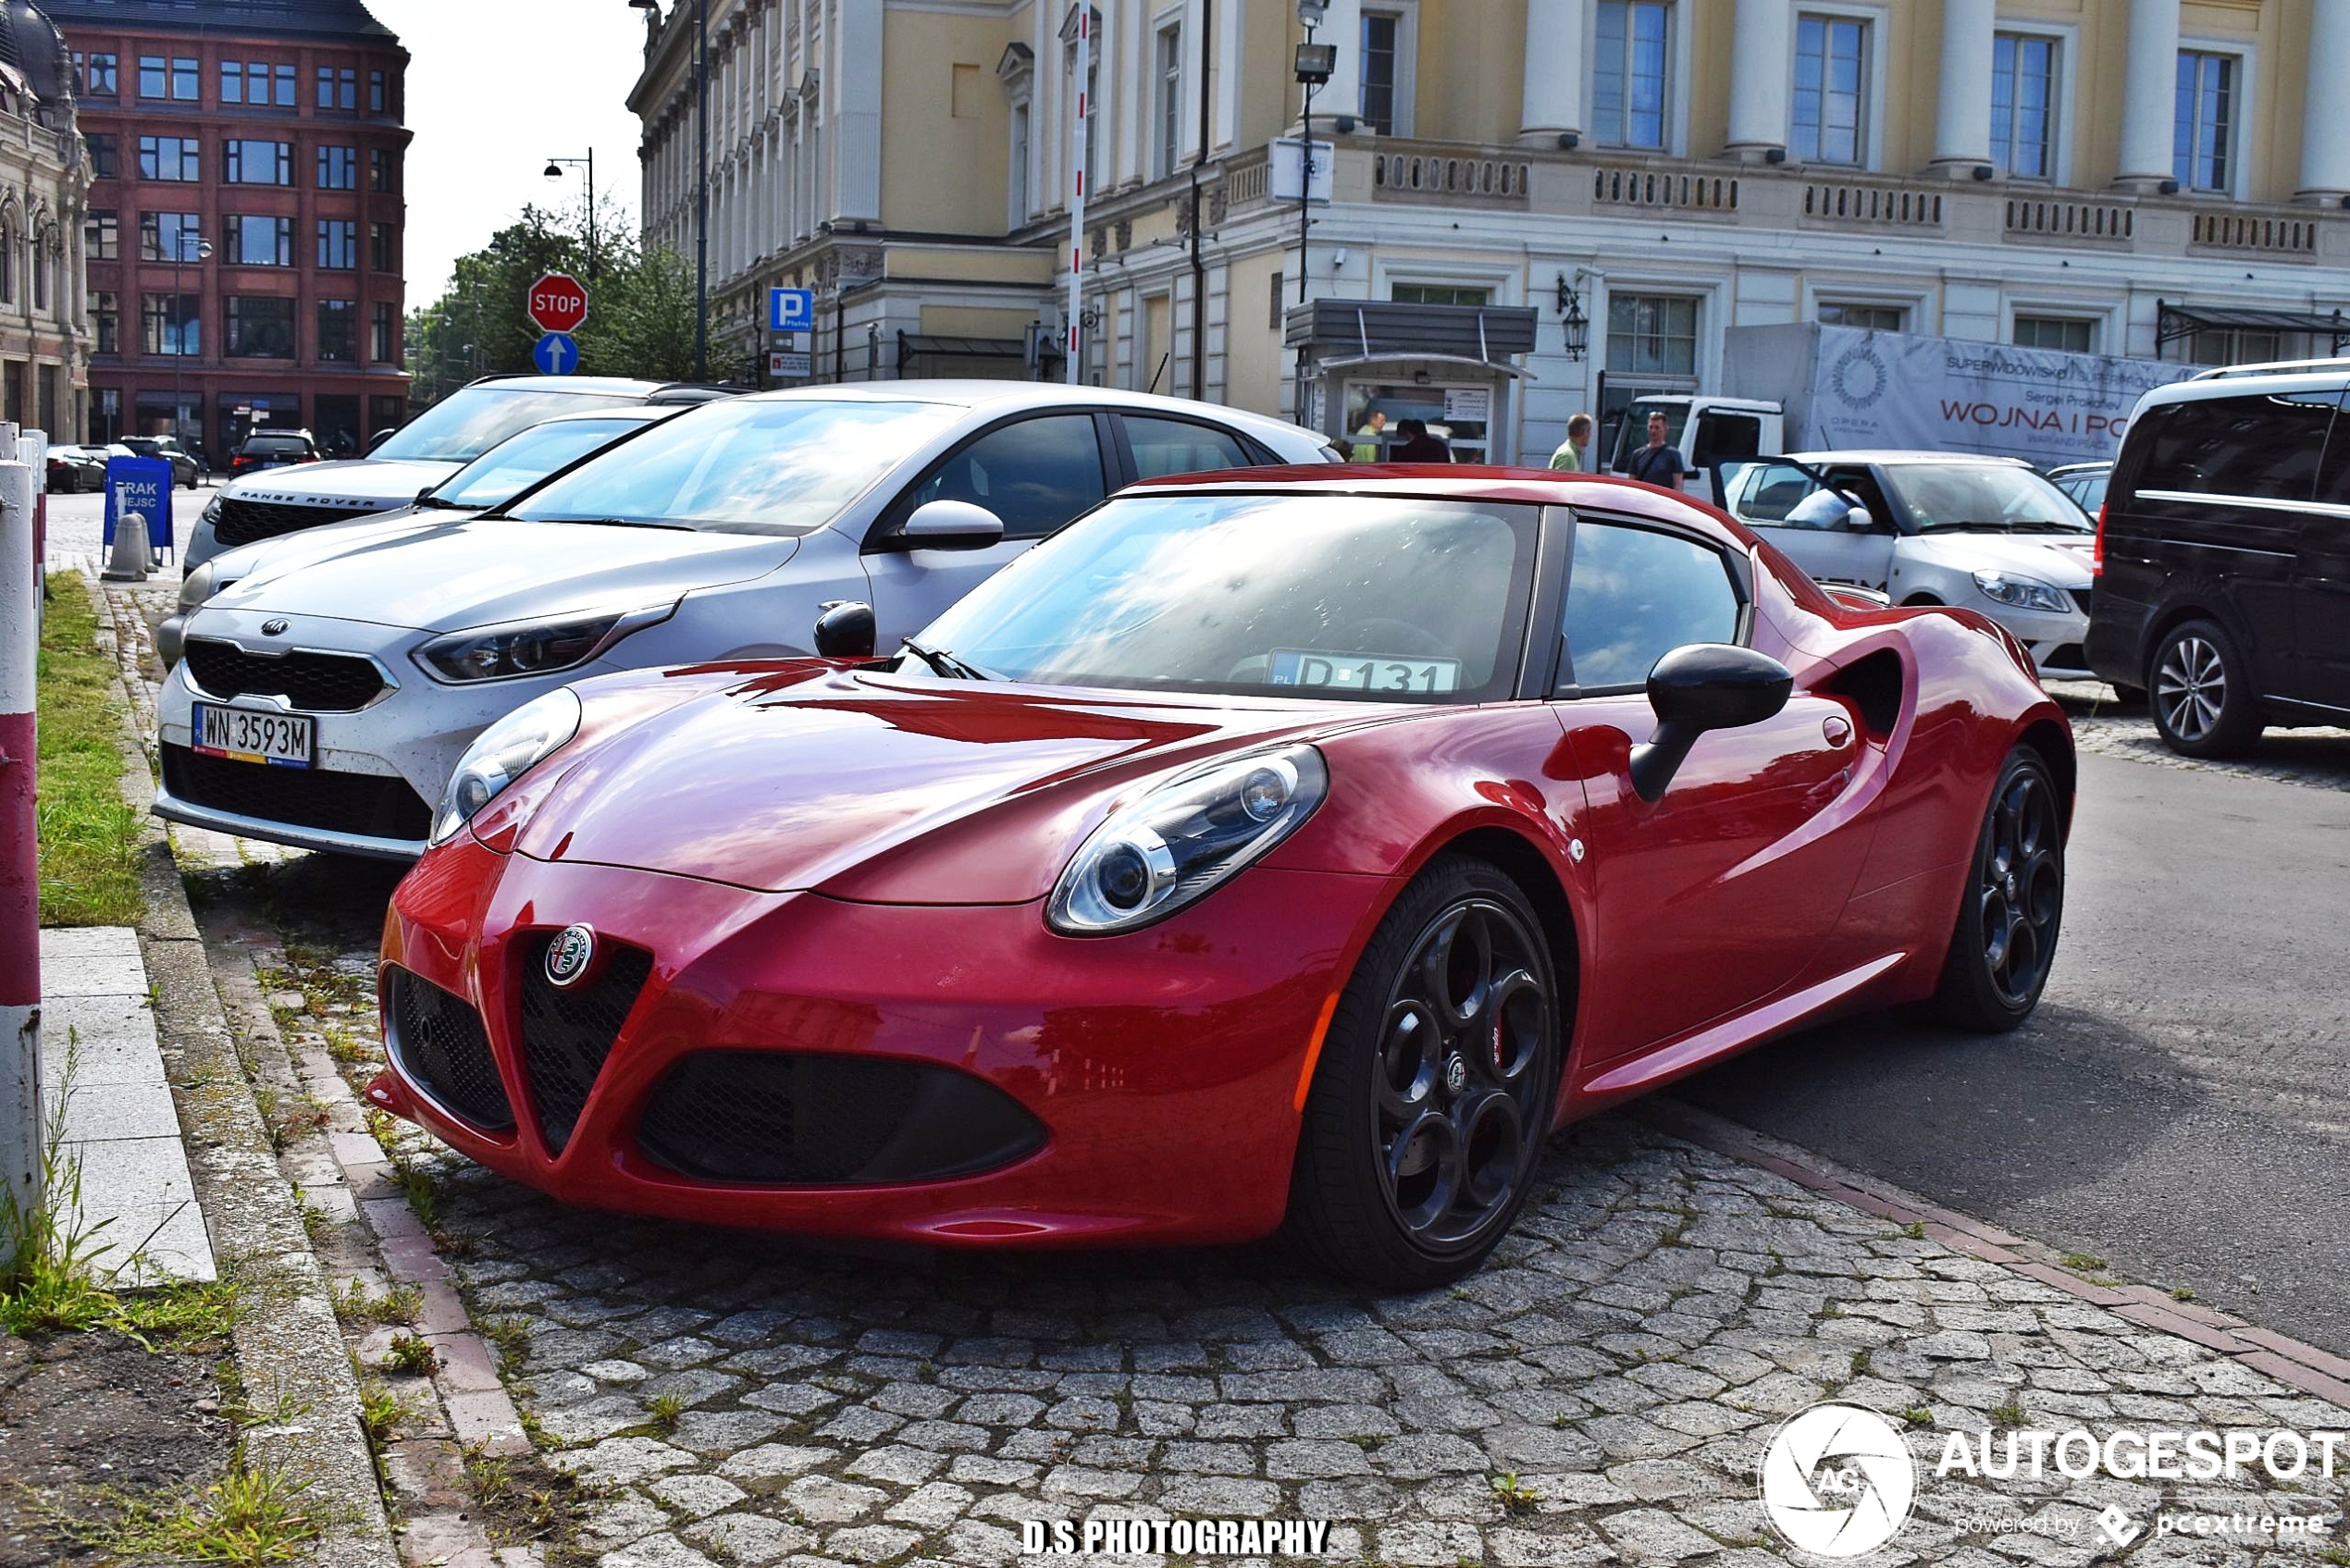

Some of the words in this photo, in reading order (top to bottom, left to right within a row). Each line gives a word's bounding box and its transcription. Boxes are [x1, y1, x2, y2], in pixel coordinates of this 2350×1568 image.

[535, 293, 581, 314] STOP
[779, 293, 803, 326] P
[1830, 416, 1879, 428] OPERA
[1940, 399, 2064, 432] WOJNA
[2072, 413, 2078, 434] I
[240, 490, 297, 501] RANGE
[305, 497, 376, 507] ROVER
[1273, 674, 1292, 685] PL
[1297, 657, 1334, 688] D
[1355, 661, 1439, 695] 131
[205, 709, 230, 747] WN
[237, 714, 305, 758] 3593M
[570, 931, 588, 959] ROMEO
